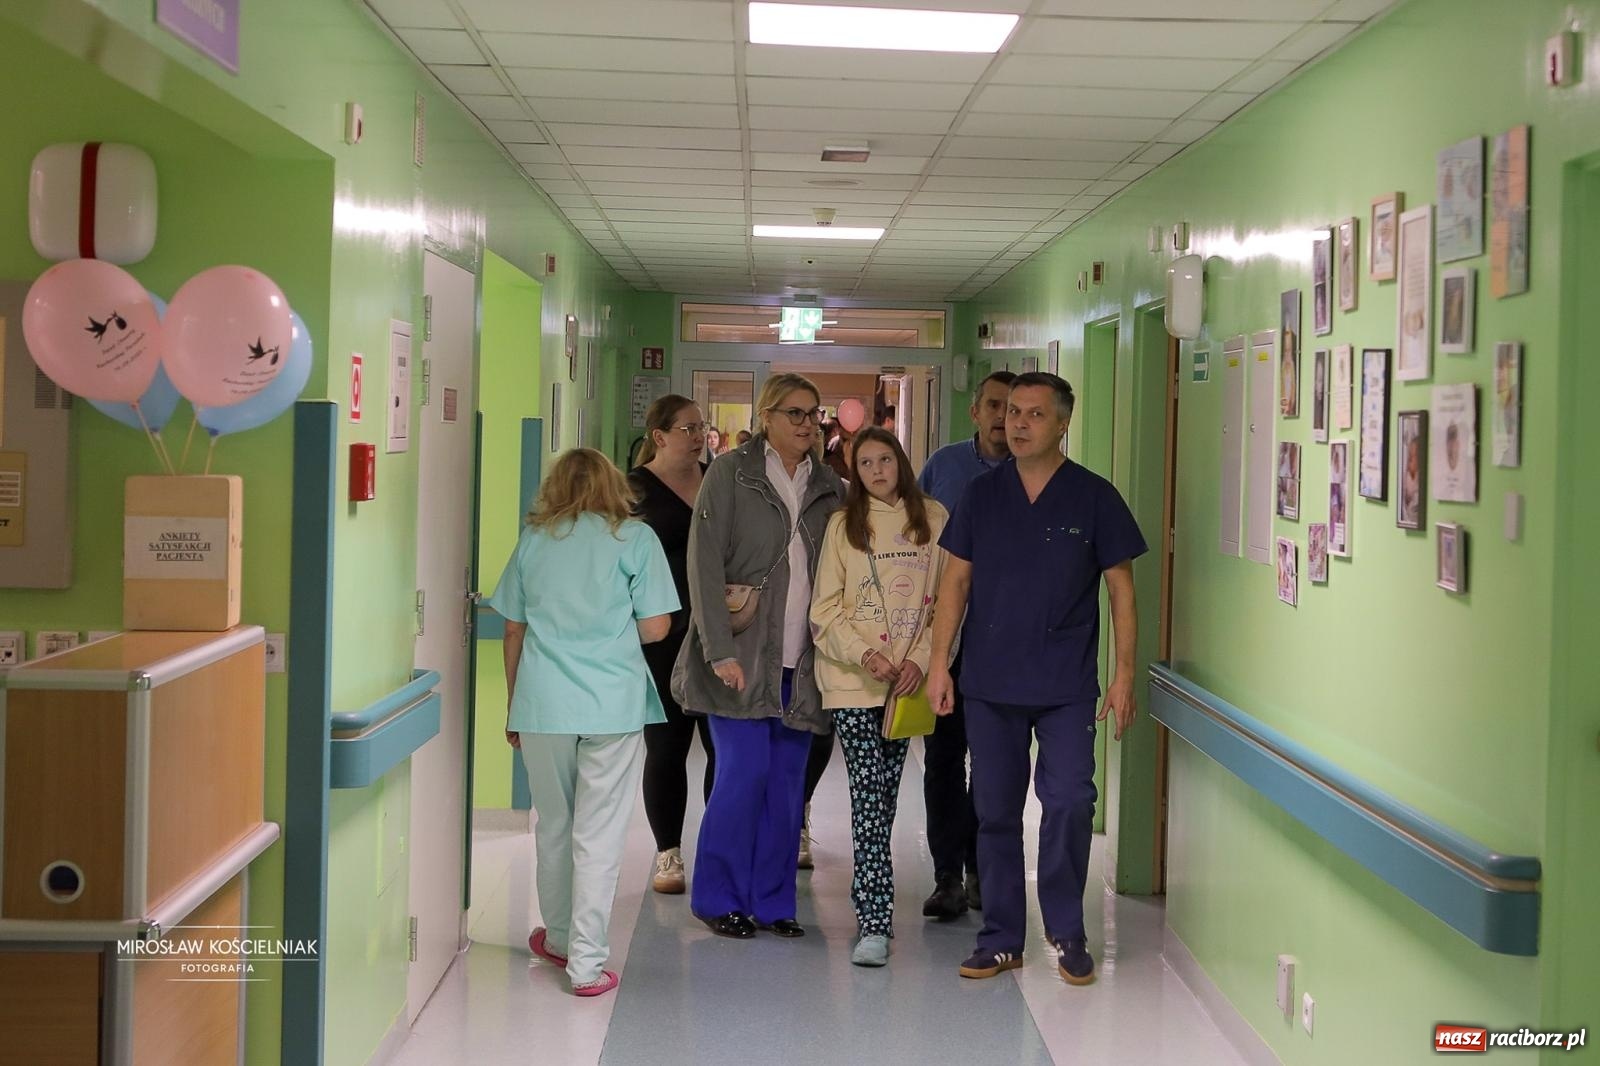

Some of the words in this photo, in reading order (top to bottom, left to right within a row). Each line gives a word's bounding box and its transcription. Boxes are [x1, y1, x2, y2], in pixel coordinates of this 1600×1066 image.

[159, 532, 201, 541] ANKIETY
[156, 552, 204, 561] PACJENTA
[878, 552, 896, 560] LIKE
